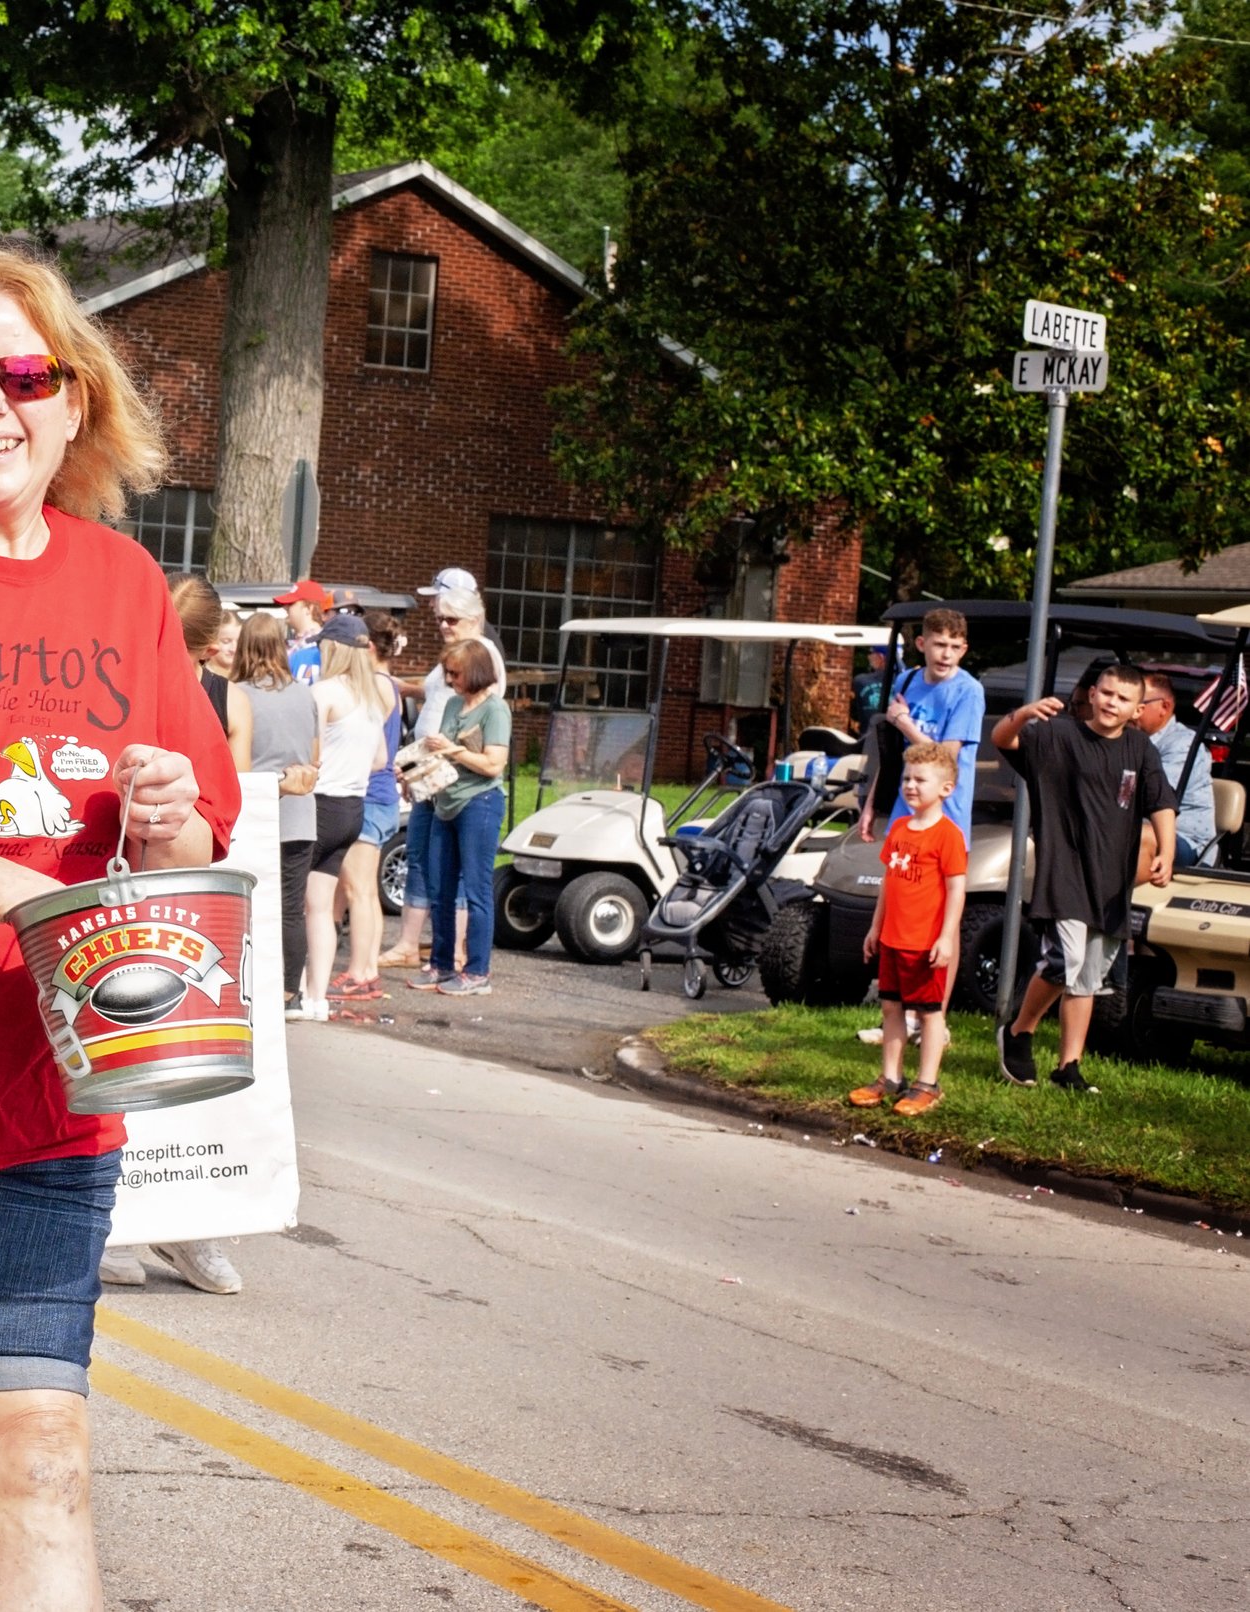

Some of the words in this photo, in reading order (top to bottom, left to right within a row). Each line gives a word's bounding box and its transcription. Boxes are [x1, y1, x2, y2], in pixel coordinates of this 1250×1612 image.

[1031, 308, 1099, 348] LABETTE
[1018, 357, 1029, 385] E
[1042, 357, 1102, 385] MCKAY
[28, 689, 82, 713] Hour
[75, 758, 99, 766] FRIED
[43, 838, 112, 861] Kansas
[1190, 899, 1218, 912] Club
[1219, 902, 1243, 915] Car
[57, 905, 137, 950] KANSAS
[150, 905, 202, 928] CITY
[62, 927, 205, 984] CHIEFS
[121, 1143, 224, 1163] ncepitt.com
[116, 1163, 248, 1188] t@hotmail.com
